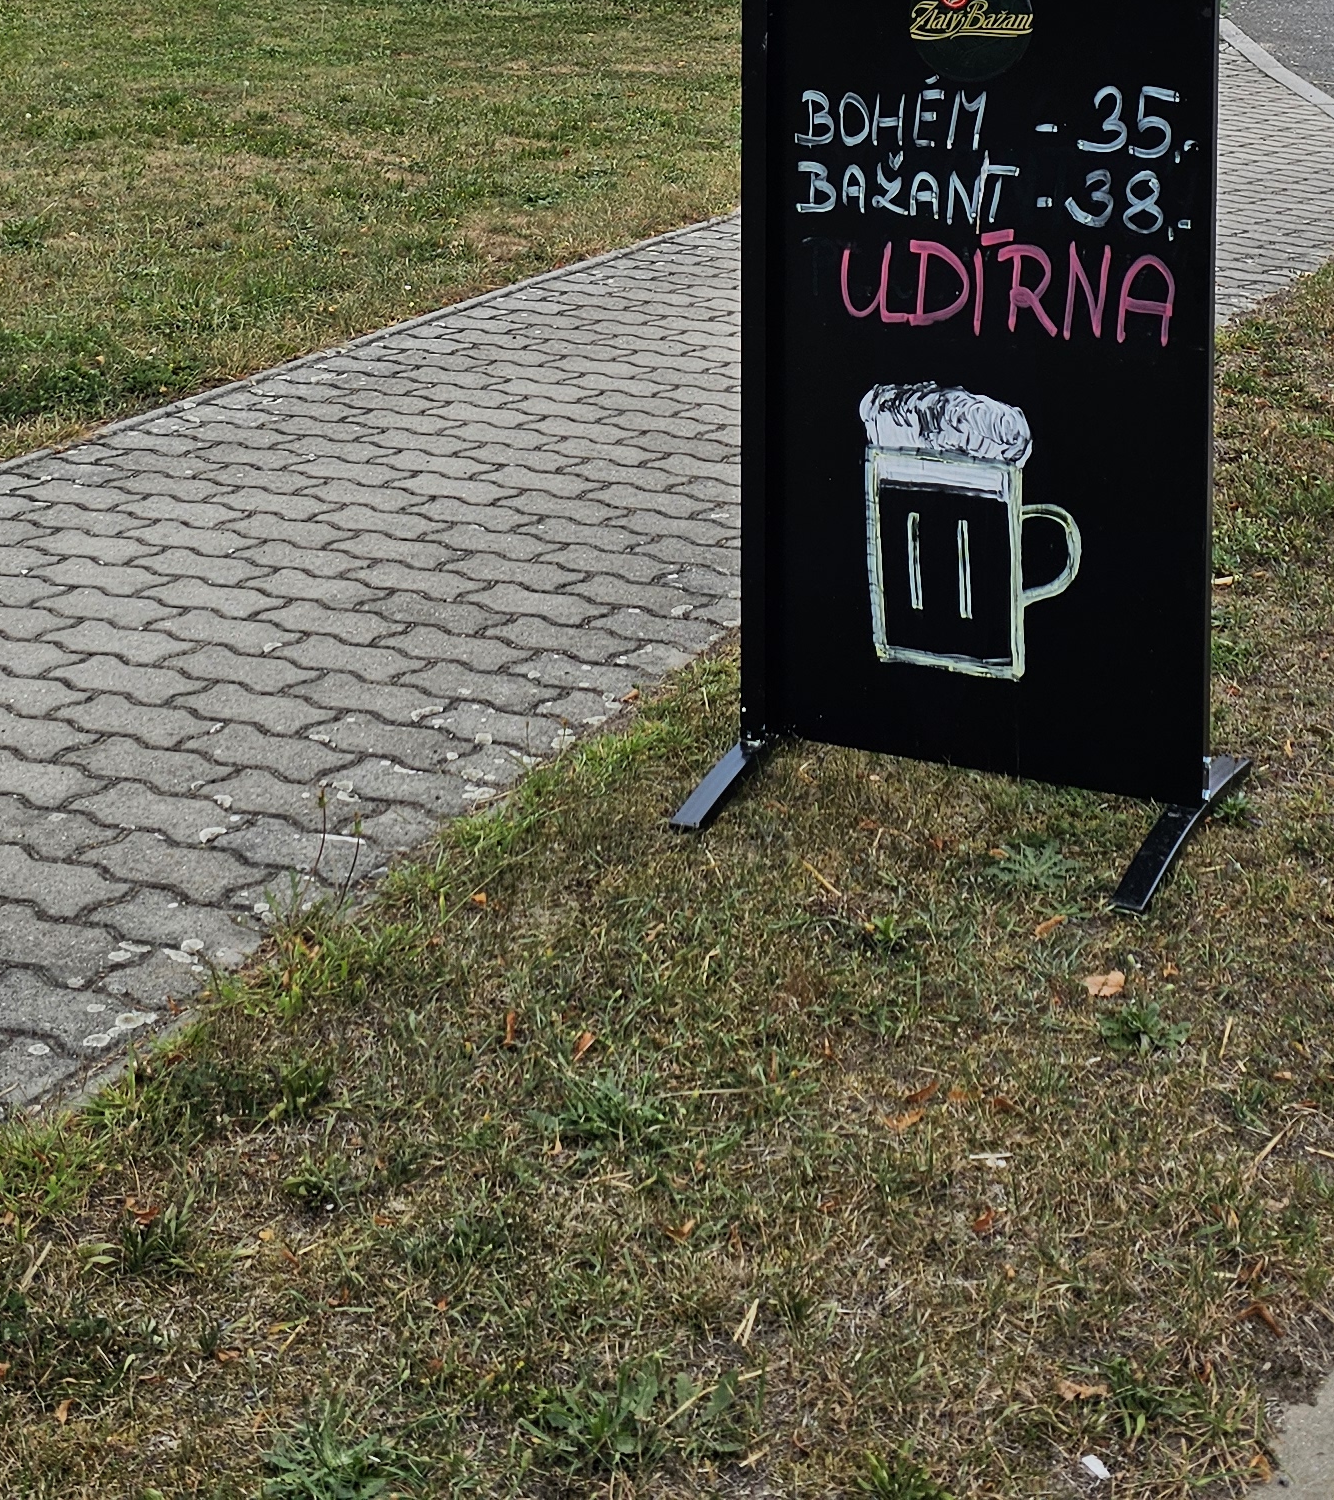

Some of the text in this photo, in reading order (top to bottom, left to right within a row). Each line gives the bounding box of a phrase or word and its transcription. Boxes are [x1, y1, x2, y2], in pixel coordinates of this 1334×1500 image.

[909, 0, 1033, 40] Zlatý Bažant
[794, 75, 988, 150] BOHÉM
[796, 151, 1020, 231] BAŽANT
[840, 228, 1175, 347] UDÍRNA
